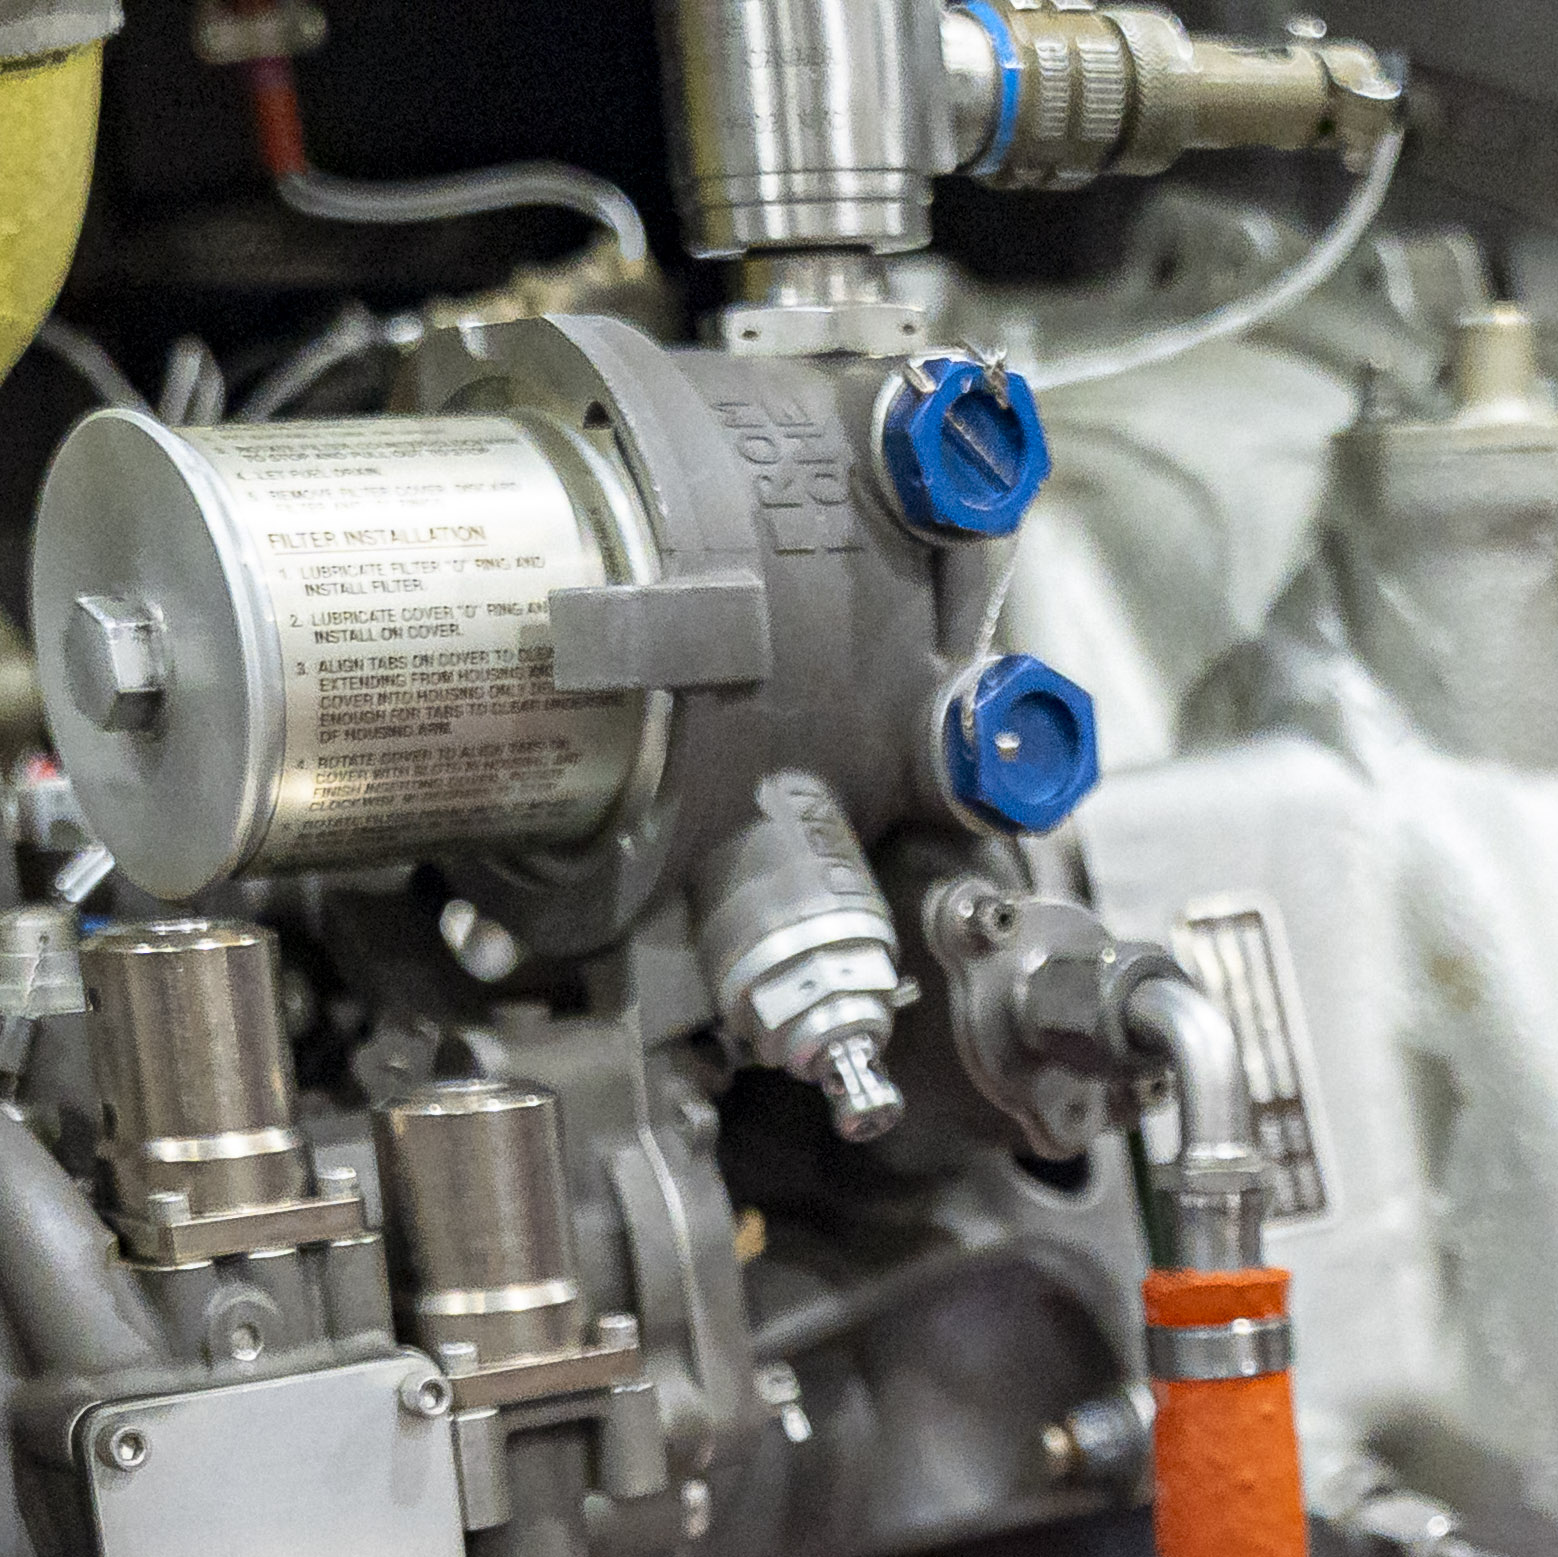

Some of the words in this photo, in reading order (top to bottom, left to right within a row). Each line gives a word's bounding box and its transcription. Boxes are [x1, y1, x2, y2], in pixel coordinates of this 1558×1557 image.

[267, 531, 337, 550] FILTER
[342, 526, 487, 547] INSTALLATION
[301, 563, 387, 581] LUBRICATE
[390, 560, 440, 576] FILTER
[304, 582, 368, 597] INSTALL
[311, 609, 397, 627] LUBRICATE
[401, 605, 454, 623] COVER
[486, 602, 524, 617] RING
[314, 630, 378, 645] INSTALL
[380, 627, 403, 641] ON
[318, 658, 364, 675] ALIGN
[366, 655, 408, 671] TABS
[412, 653, 435, 669] ON
[438, 650, 490, 667] COVER
[319, 673, 408, 693] EXTENDING
[411, 670, 454, 688] FROM
[319, 693, 374, 711] COVER
[377, 690, 413, 707] INTO
[417, 686, 486, 705] HOUSING
[319, 709, 387, 728] ENOUGH
[390, 707, 421, 723] FOR
[424, 703, 465, 721] TABS
[319, 729, 342, 745] OF
[318, 753, 375, 769] ROTATE
